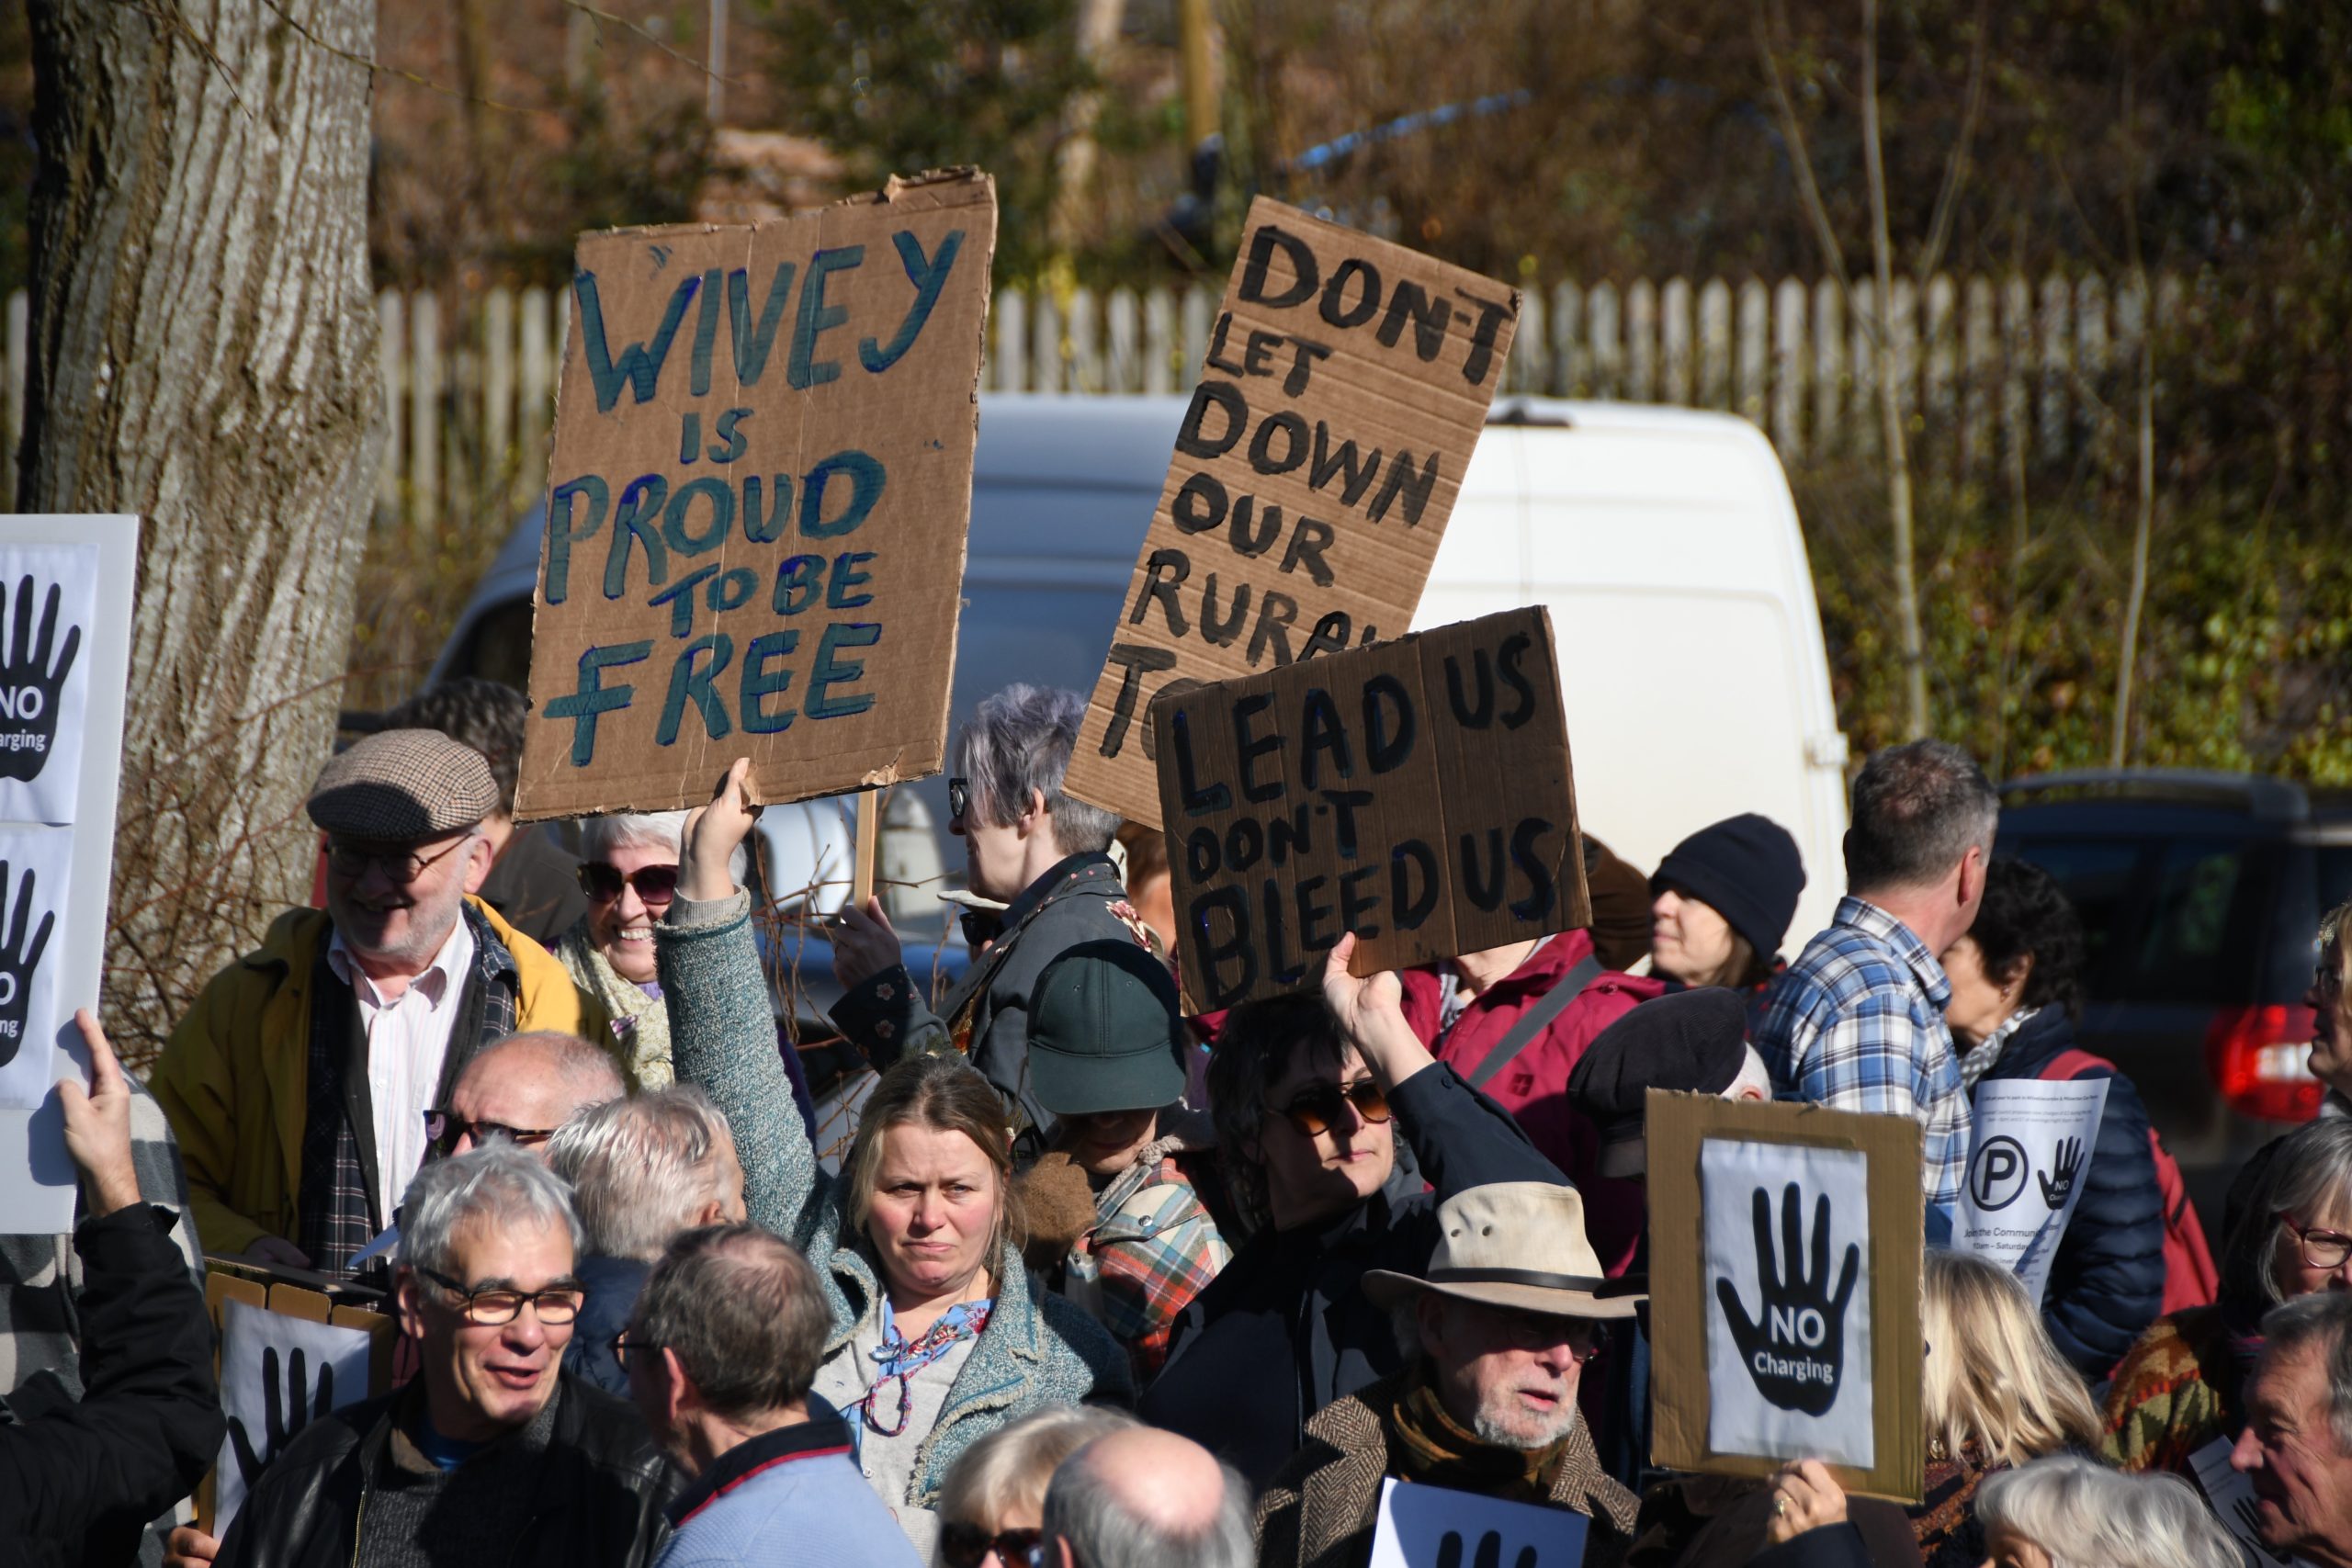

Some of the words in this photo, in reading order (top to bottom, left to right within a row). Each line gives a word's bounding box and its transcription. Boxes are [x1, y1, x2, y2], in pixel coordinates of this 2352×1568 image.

[573, 229, 967, 414] WIVEY
[1205, 311, 1333, 399] LET
[680, 407, 755, 465] IS
[1175, 379, 1441, 528] DOWN
[545, 449, 888, 606] PROUD
[1171, 471, 1335, 588] OUR
[647, 561, 761, 639] TO
[772, 551, 878, 616] BE
[0, 728, 46, 751] arging
[541, 622, 883, 768] FREE
[1171, 672, 1417, 817] LEAD
[1443, 631, 1536, 731] US
[1186, 789, 1374, 886] DON'T
[1189, 838, 1440, 1010] BLEED
[1459, 817, 1556, 923] US
[0, 971, 17, 1006] O
[1981, 1148, 2018, 1201] P
[1753, 1350, 1835, 1384] Charging
[1770, 1303, 1826, 1348] NO
